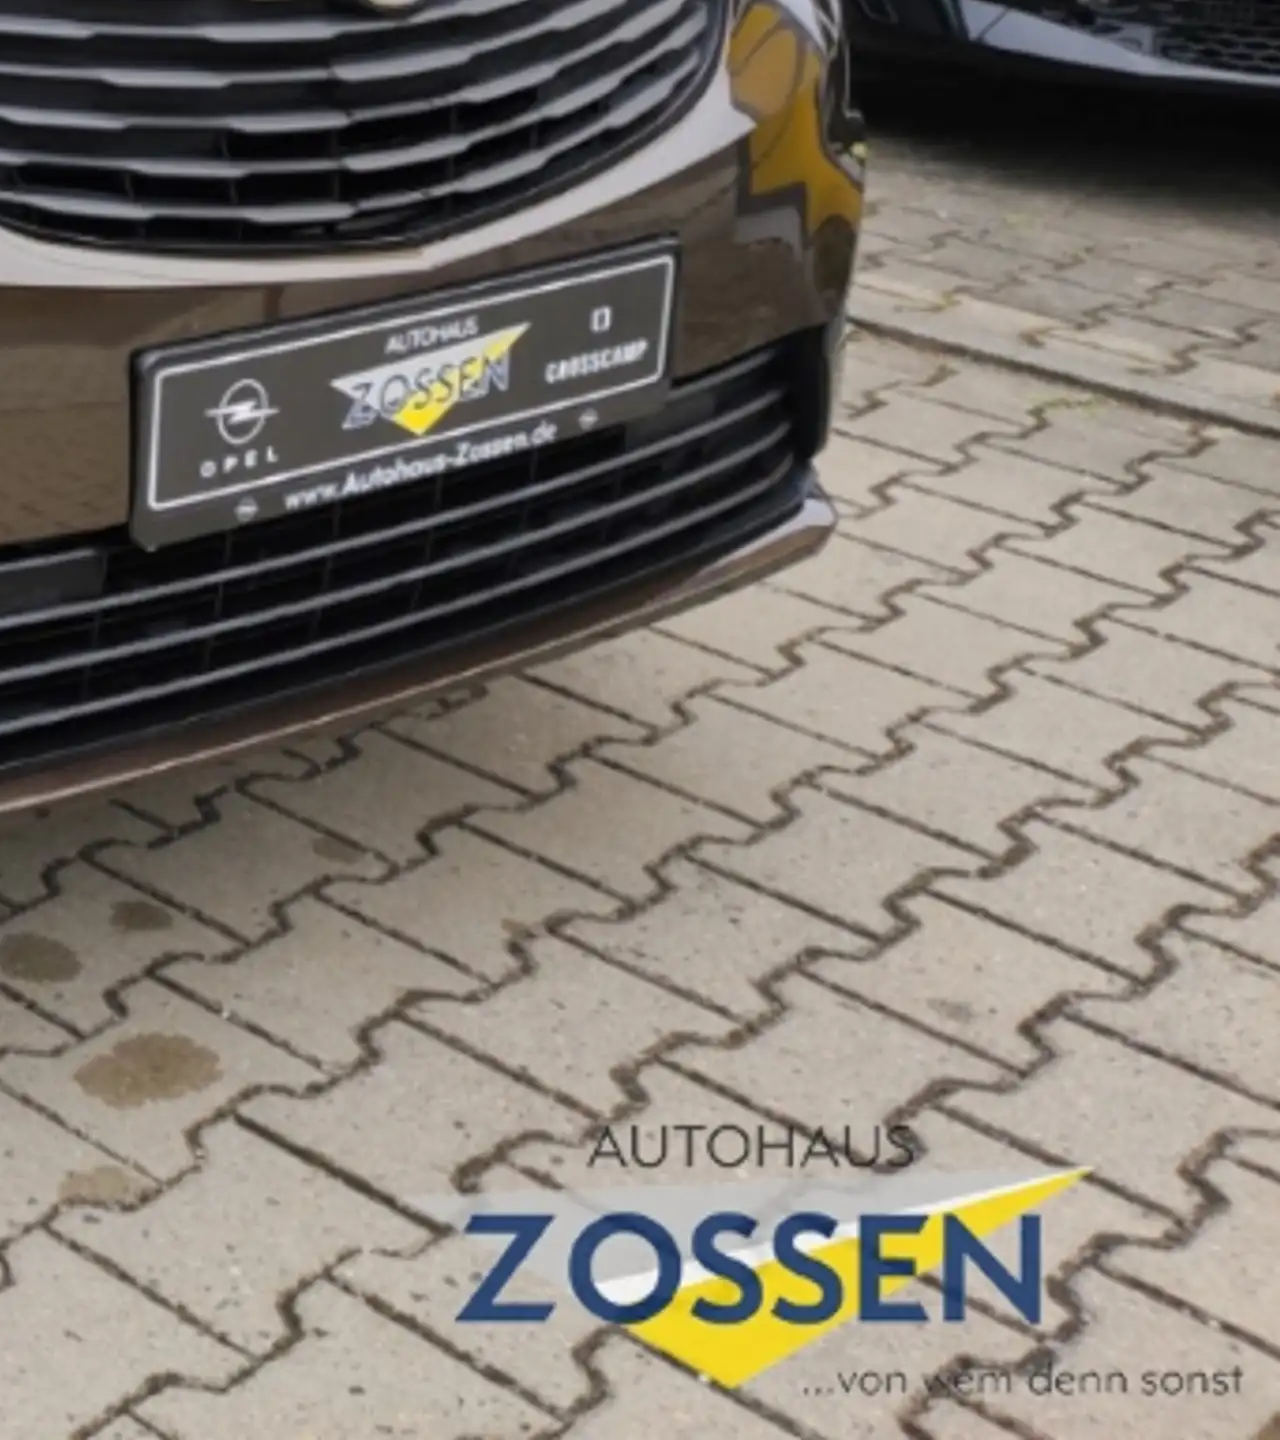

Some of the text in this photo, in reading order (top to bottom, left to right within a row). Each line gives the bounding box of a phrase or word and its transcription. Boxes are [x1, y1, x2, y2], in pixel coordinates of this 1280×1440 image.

[384, 315, 480, 355] AUTOHAUS
[341, 349, 512, 430] ZOSSEN
[199, 445, 280, 478] OPEL
[283, 419, 558, 511] www.Autohaus-Zossen.de
